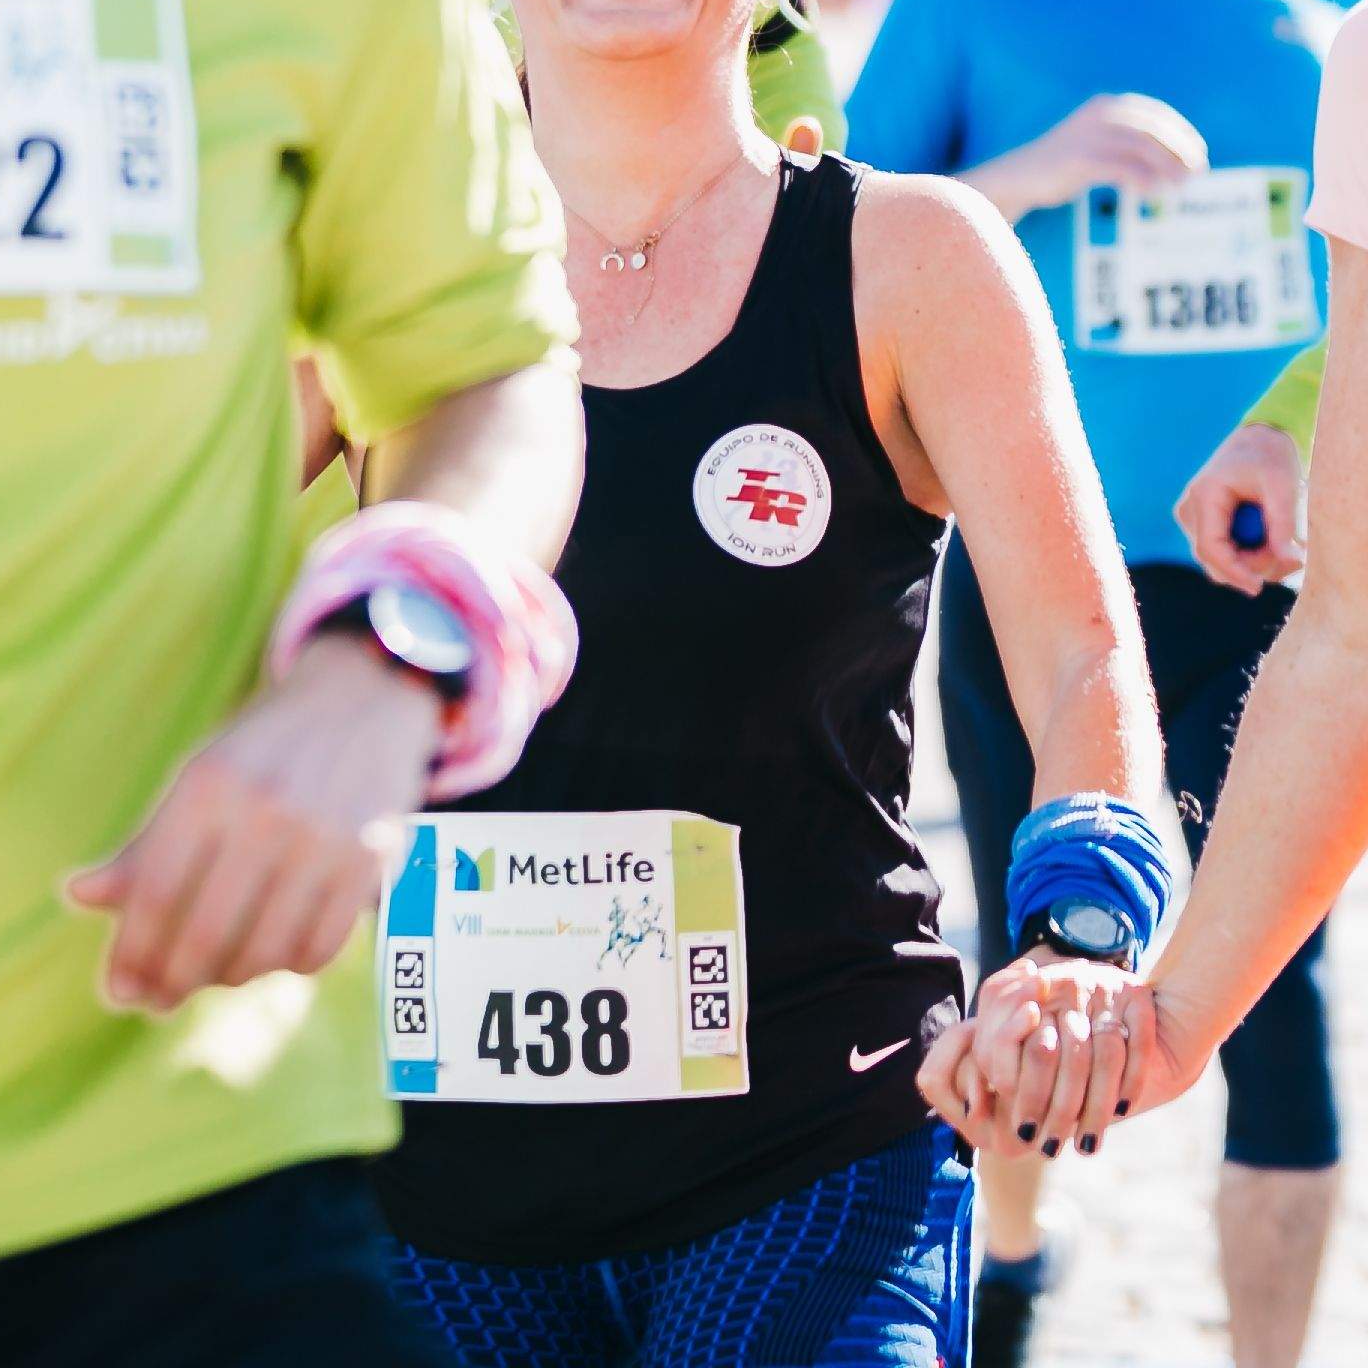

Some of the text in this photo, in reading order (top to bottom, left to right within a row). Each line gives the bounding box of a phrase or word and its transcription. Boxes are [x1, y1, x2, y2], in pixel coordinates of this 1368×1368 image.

[707, 432, 825, 500] EQUIPO DE RUNNING
[762, 543, 796, 559] RUN
[509, 851, 655, 885] MetLife
[477, 988, 631, 1077] 438
